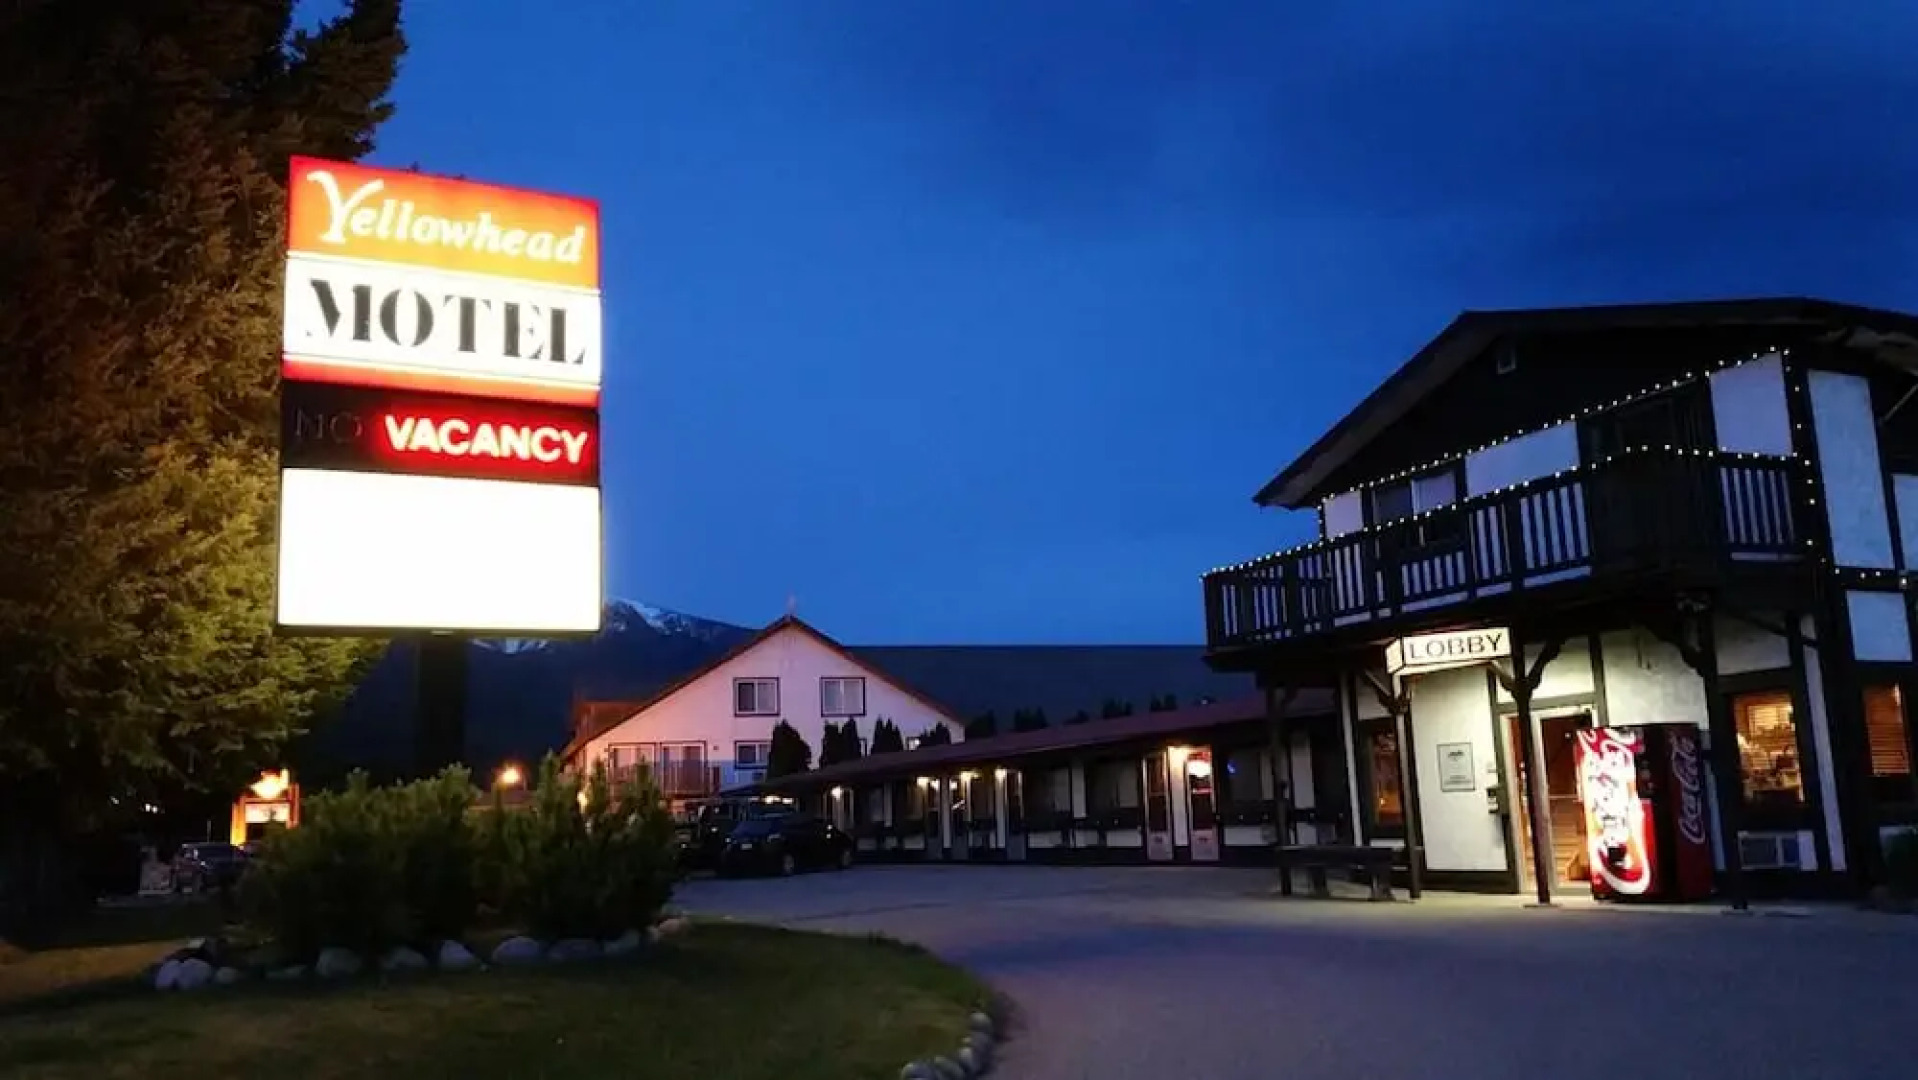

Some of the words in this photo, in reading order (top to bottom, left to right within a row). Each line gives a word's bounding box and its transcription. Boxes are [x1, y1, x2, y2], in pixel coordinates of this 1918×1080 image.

[306, 170, 586, 264] Yellowhead
[306, 277, 586, 365] MOTEL
[295, 407, 363, 443] NO
[384, 413, 588, 465] VACANCY
[1409, 632, 1502, 659] LOBBY
